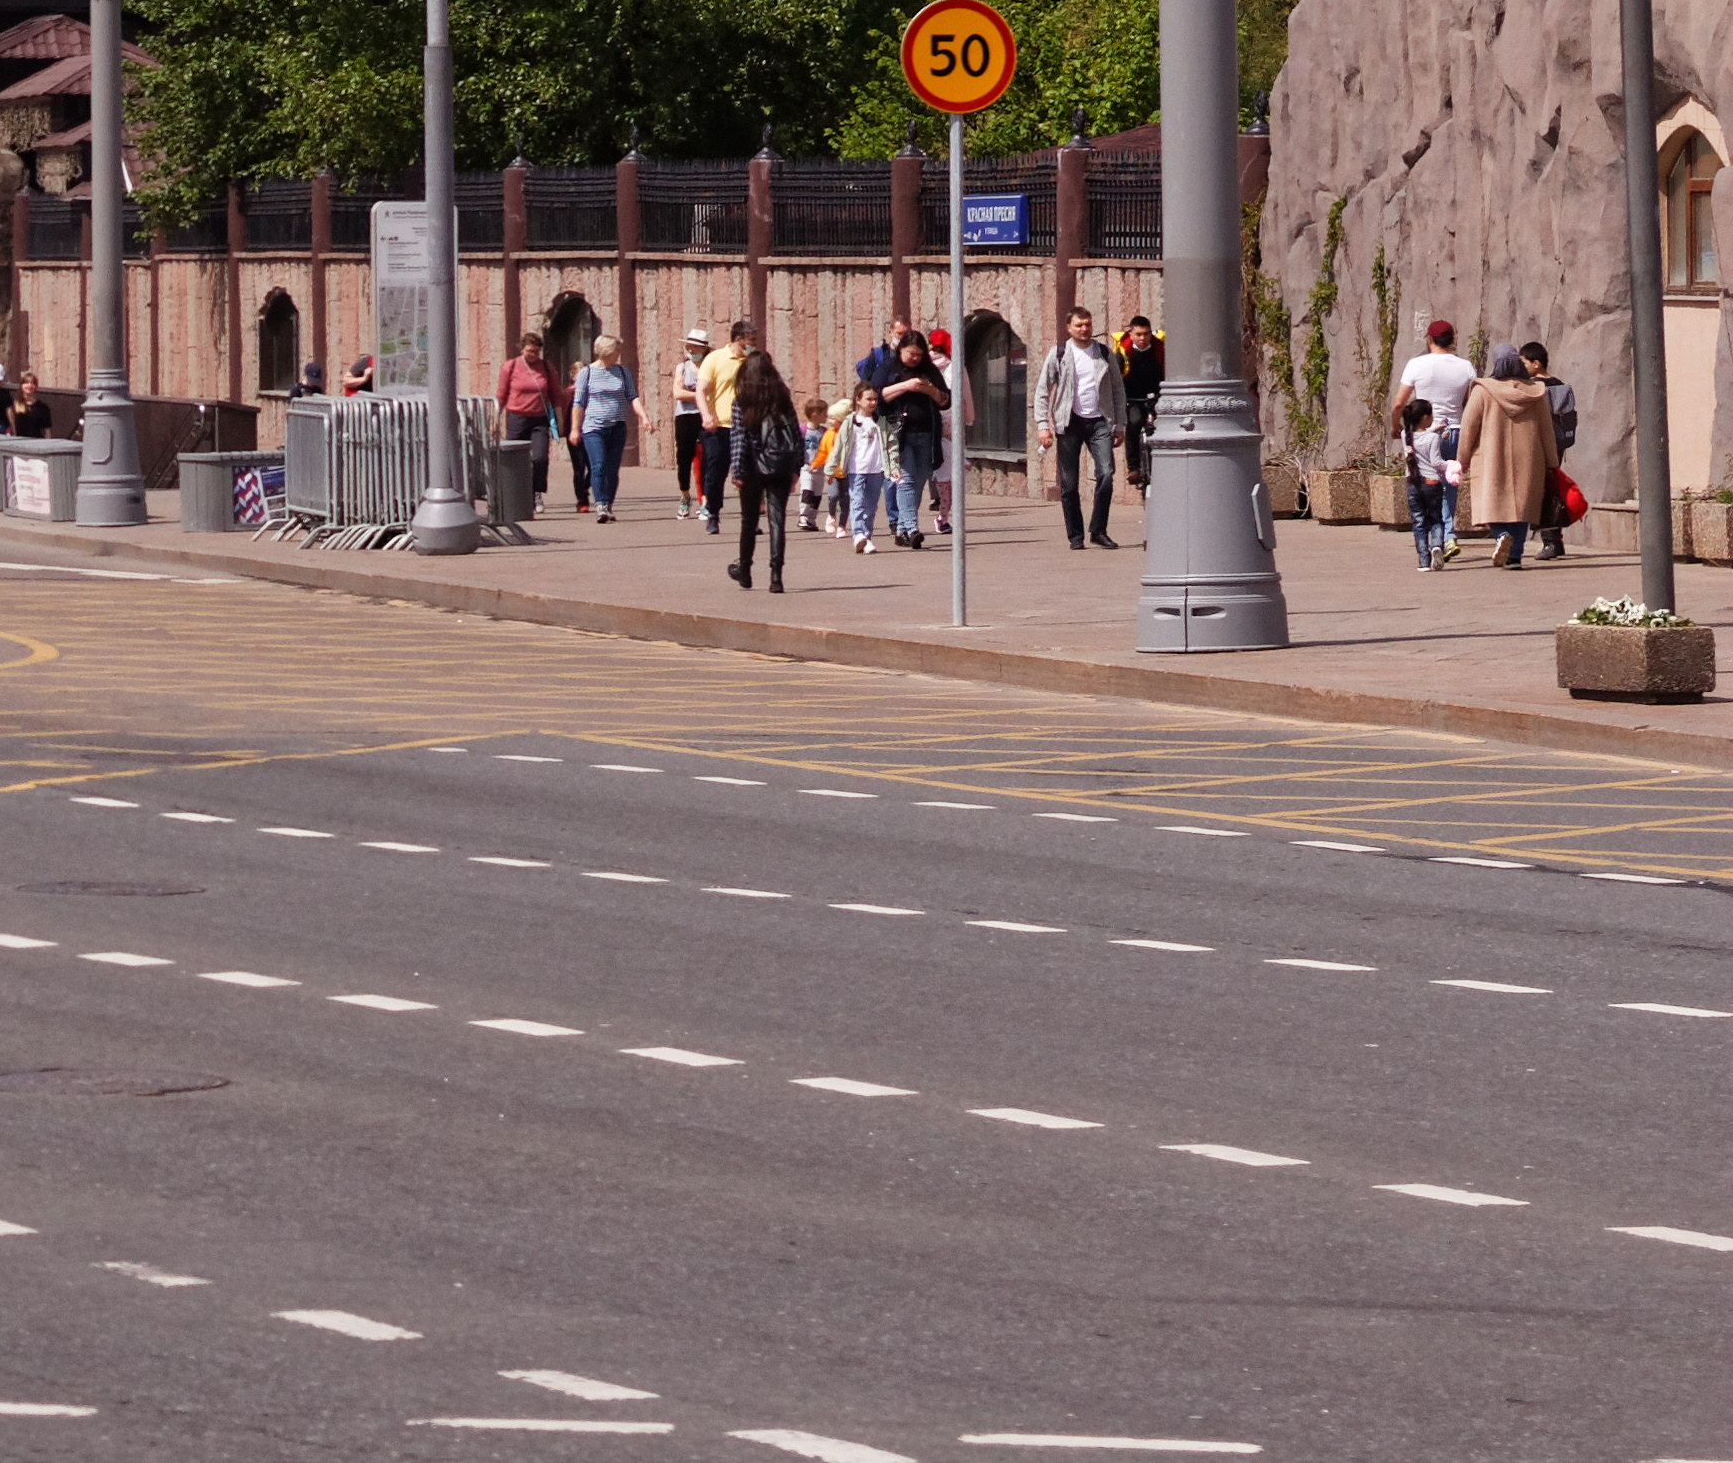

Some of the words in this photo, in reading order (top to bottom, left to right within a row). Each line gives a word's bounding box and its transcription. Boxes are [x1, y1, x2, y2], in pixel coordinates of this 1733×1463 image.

[930, 34, 989, 77] 50
[967, 206, 993, 222] КРАСНАЯ
[994, 206, 1016, 221] ПРЕСНЯ
